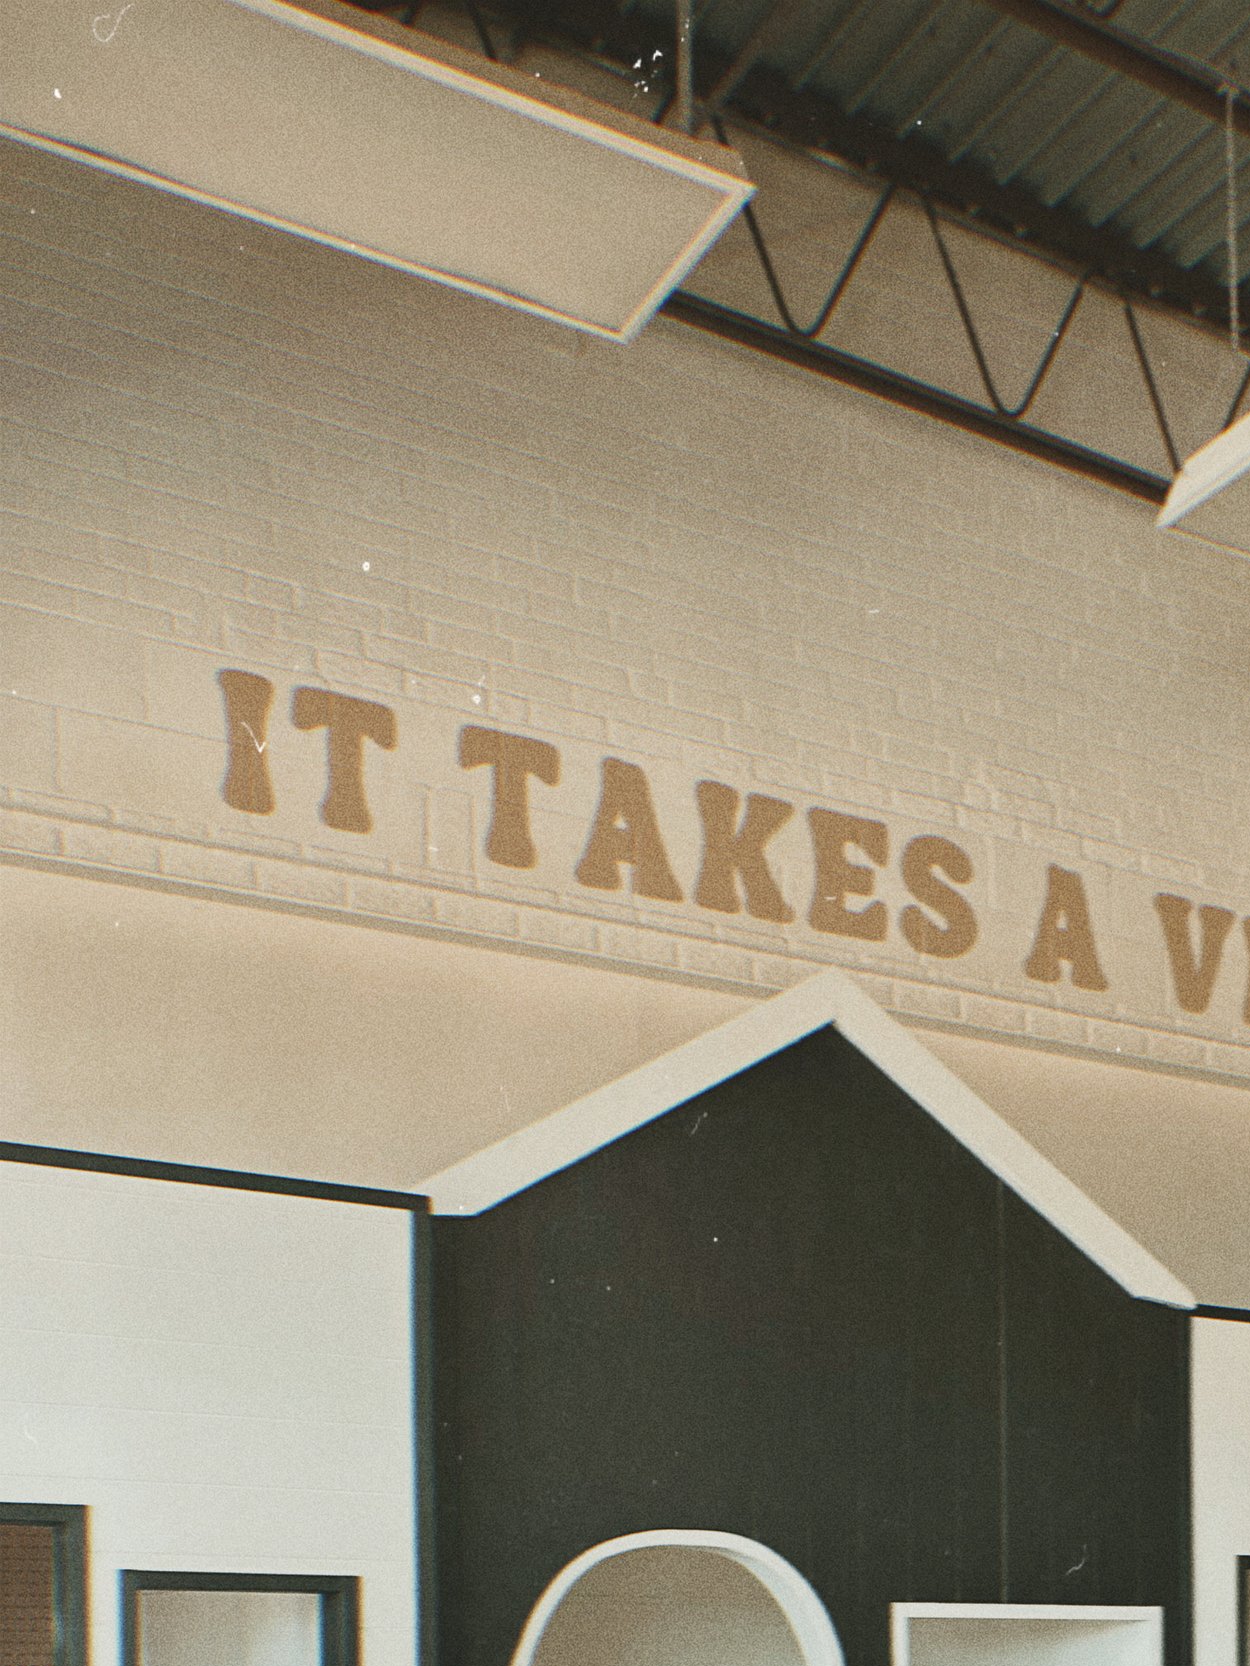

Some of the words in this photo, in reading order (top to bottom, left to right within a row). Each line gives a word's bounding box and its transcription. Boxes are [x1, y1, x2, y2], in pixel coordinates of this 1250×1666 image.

[216, 667, 398, 835] IT
[456, 724, 980, 960] TAKES
[1023, 863, 1108, 992] A
